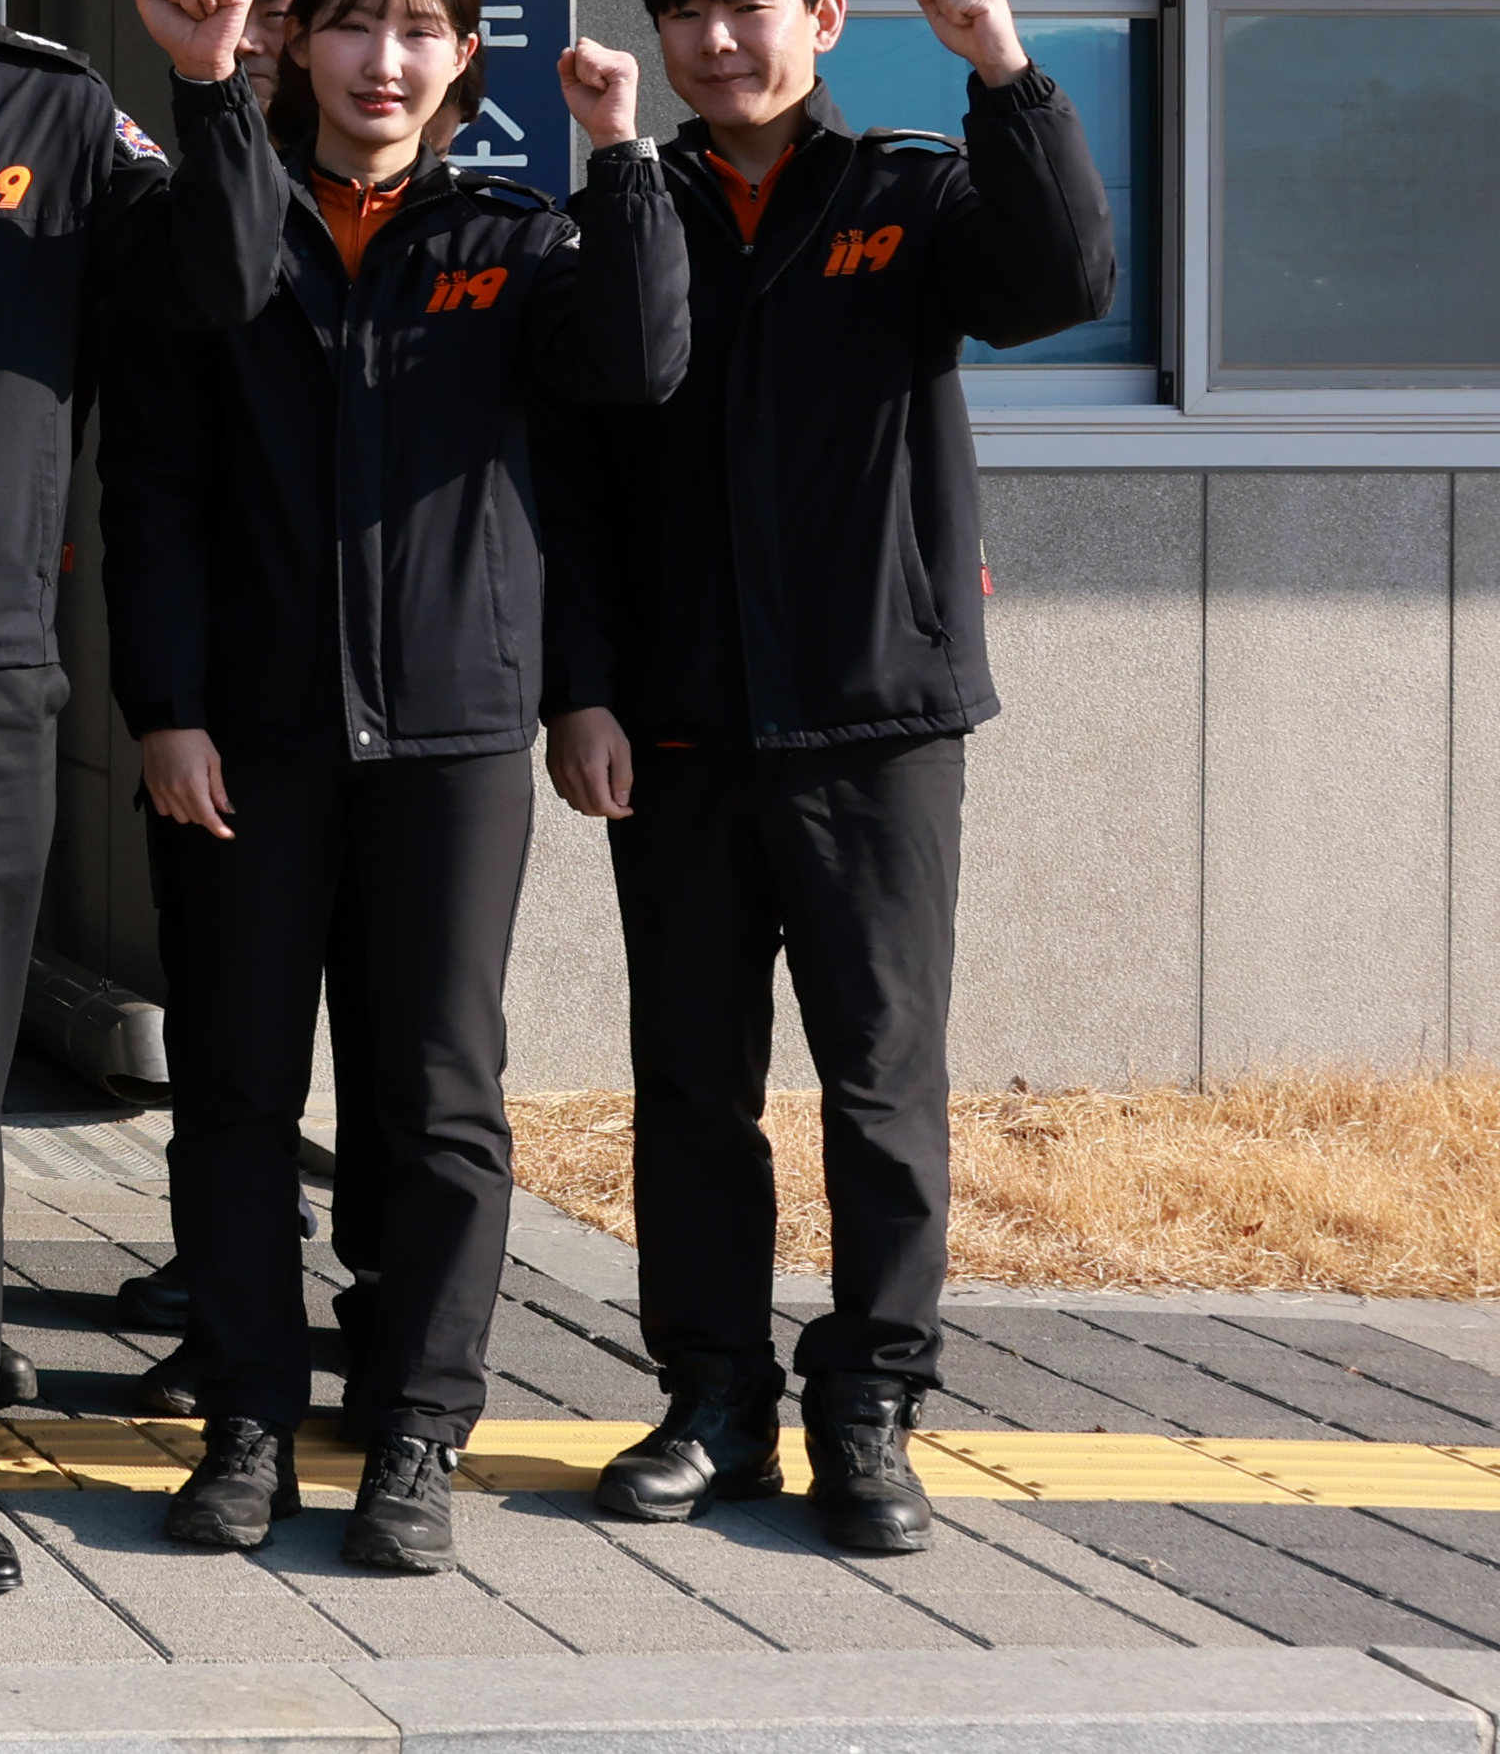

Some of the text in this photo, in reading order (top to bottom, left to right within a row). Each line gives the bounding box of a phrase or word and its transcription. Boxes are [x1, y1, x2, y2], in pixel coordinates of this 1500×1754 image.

[823, 225, 904, 277] 119
[830, 229, 865, 245] 소방
[425, 267, 508, 313] 119
[434, 270, 468, 285] 소방
